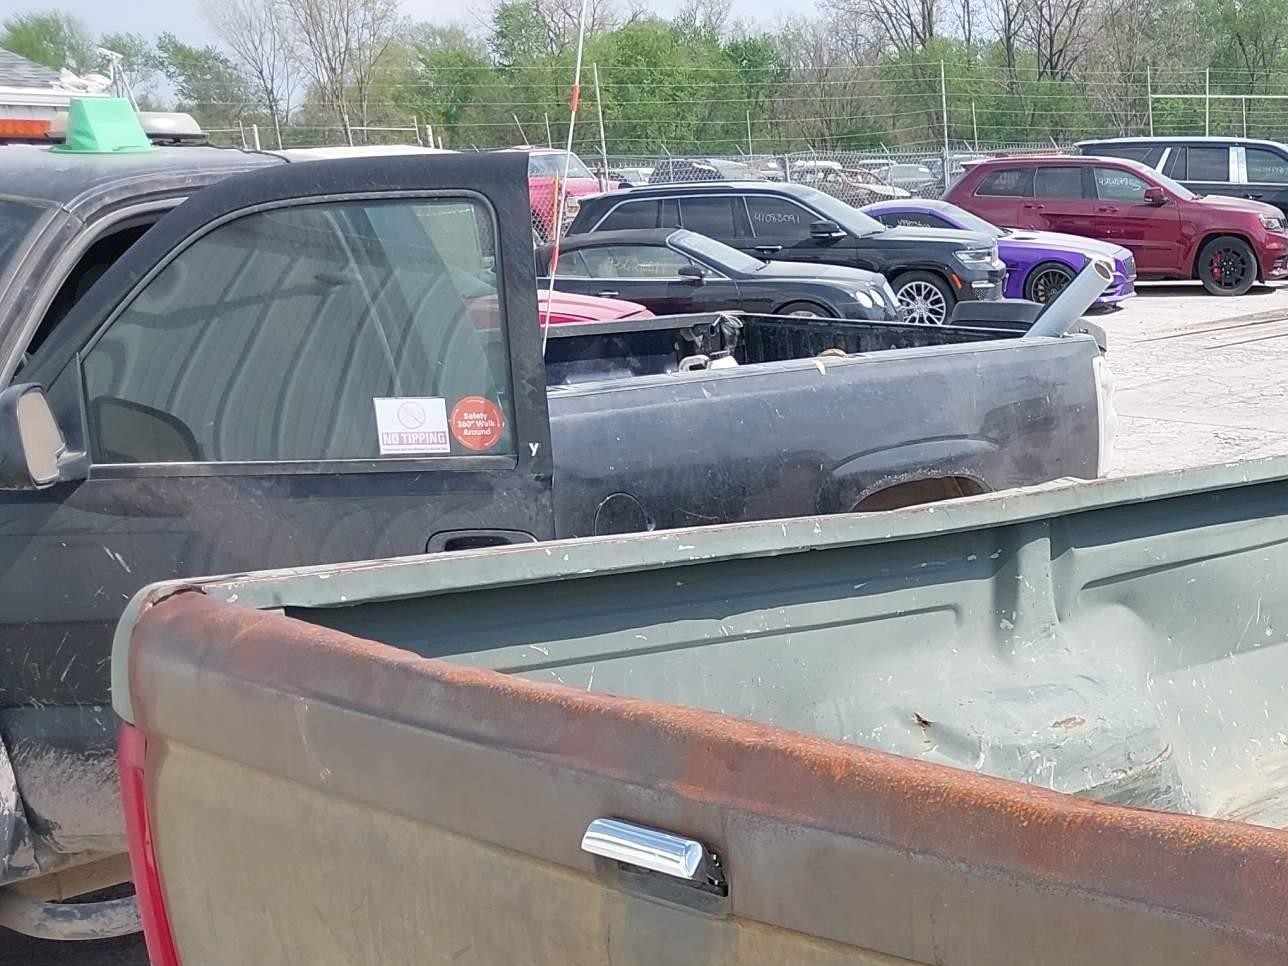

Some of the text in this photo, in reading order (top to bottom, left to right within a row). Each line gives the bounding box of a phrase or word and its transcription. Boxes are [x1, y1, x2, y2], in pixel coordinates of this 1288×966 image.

[463, 412, 488, 421] Safety
[475, 420, 496, 428] Walk
[463, 428, 492, 436] Around
[383, 431, 446, 445] NO TIPPING
